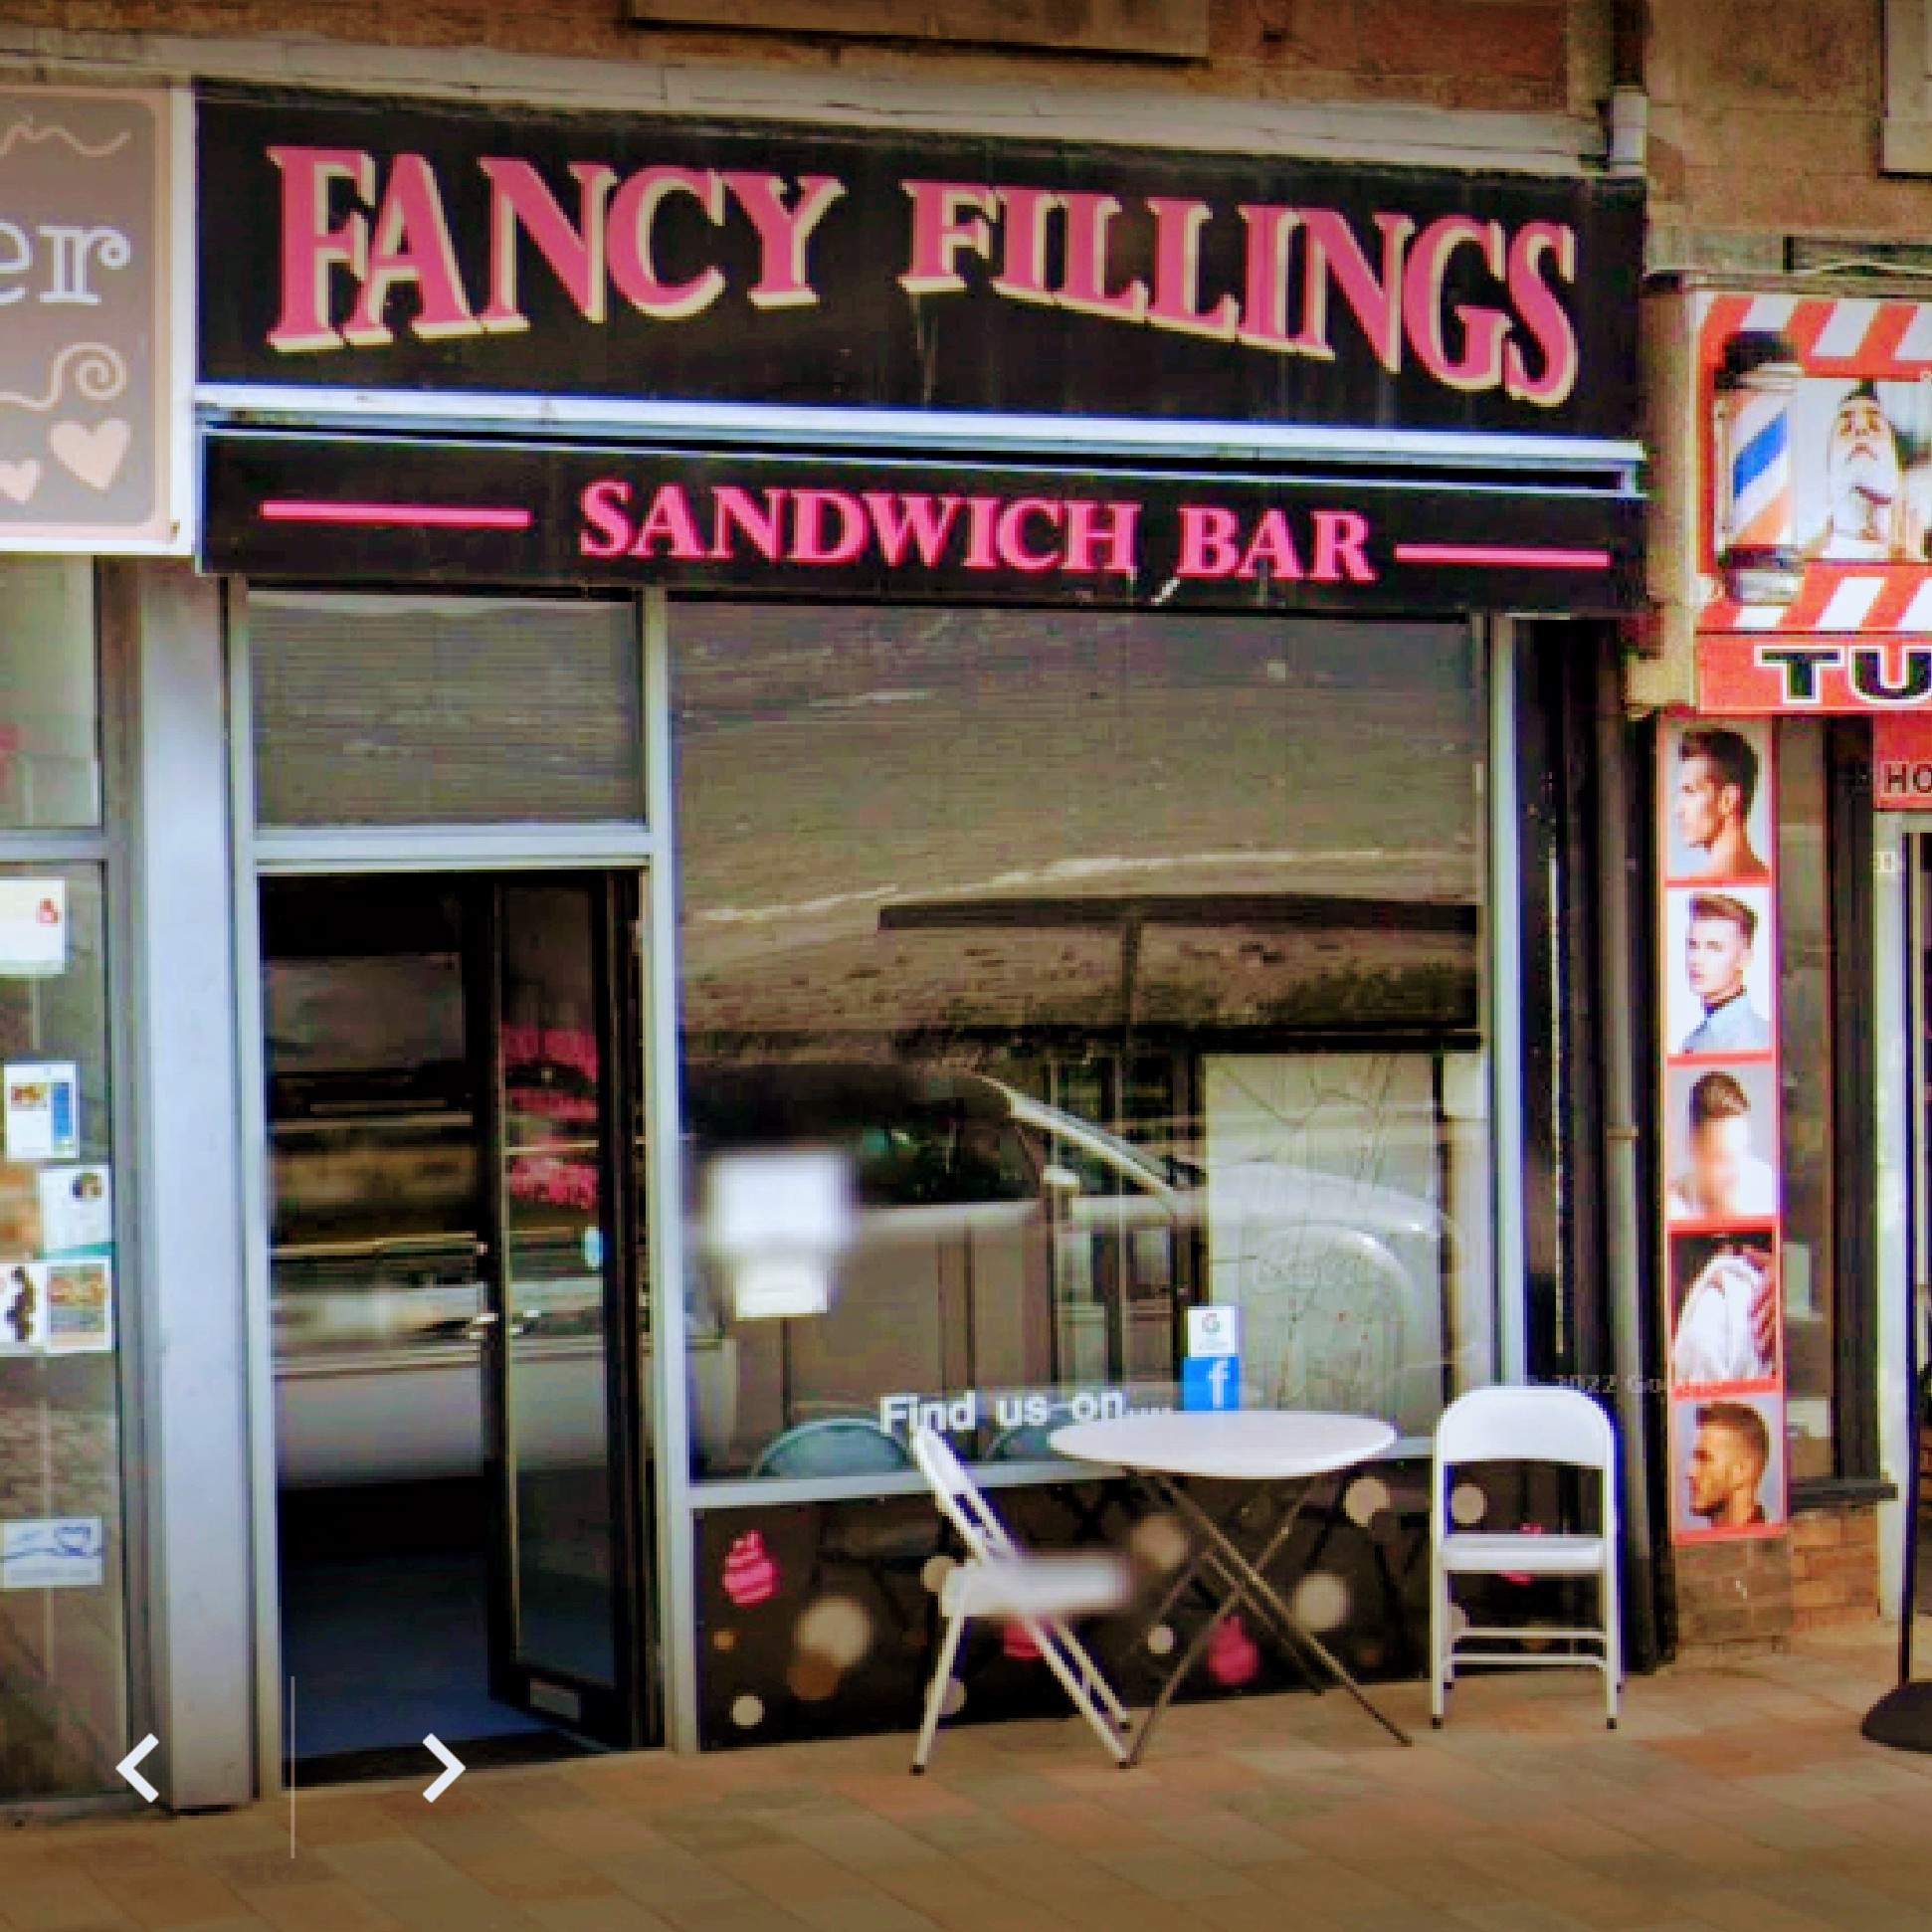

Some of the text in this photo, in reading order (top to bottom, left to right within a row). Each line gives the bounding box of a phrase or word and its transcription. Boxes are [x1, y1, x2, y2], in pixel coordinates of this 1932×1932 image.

[266, 145, 1579, 409] FANCY FILLINGS
[578, 480, 1375, 584] SANDWICH BAR
[1754, 645, 1932, 705] TU
[879, 1390, 976, 1434] Find
[996, 1395, 1048, 1428] us
